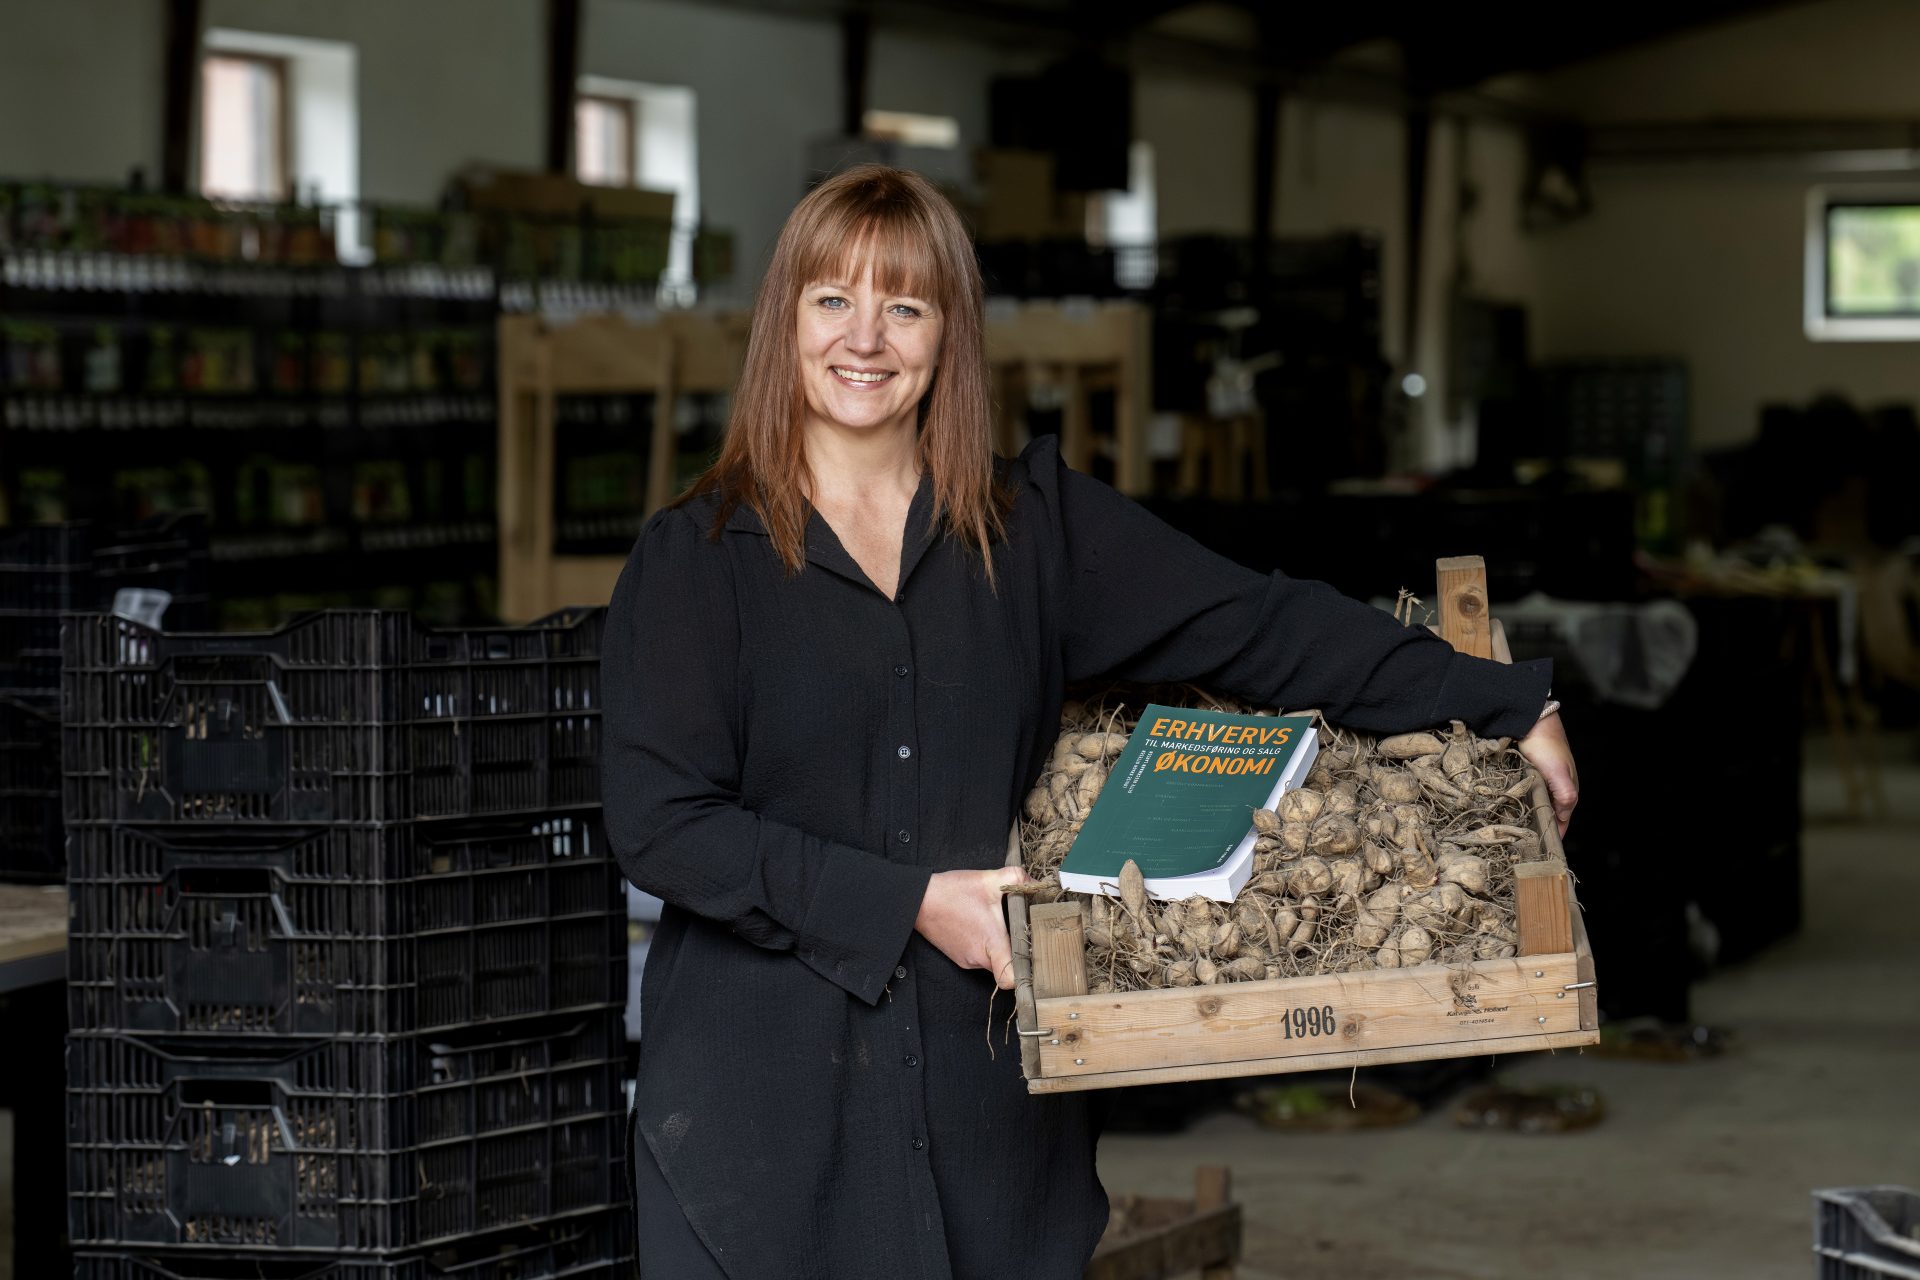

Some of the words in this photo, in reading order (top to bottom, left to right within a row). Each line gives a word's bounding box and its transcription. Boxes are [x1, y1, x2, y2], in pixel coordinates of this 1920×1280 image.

[1150, 718, 1293, 745] ERHVERVS
[1145, 738, 1158, 748] TIL
[1161, 741, 1240, 755] MARKEDSFØRING
[1242, 747, 1255, 755] OG
[1257, 747, 1282, 755] SALG
[1153, 750, 1276, 775] ØKONOMI
[1281, 1005, 1336, 1039] 1996
